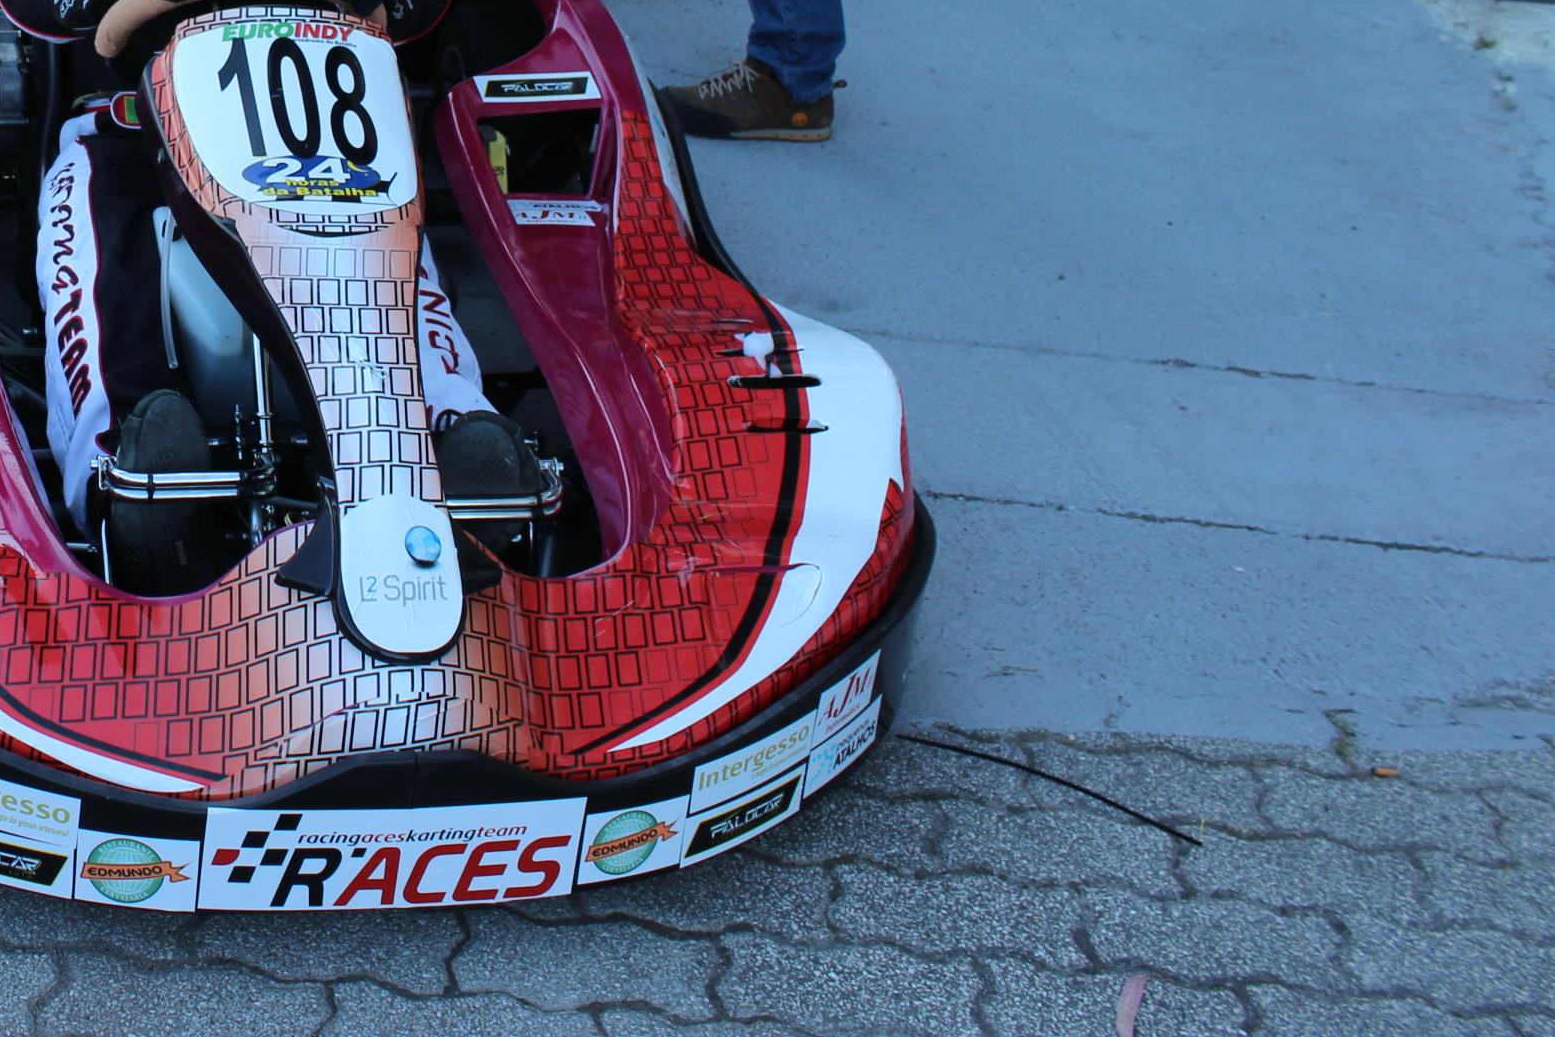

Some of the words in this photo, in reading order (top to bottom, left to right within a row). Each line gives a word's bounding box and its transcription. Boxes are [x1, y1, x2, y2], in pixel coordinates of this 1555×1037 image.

[222, 22, 356, 42] EUROINDY
[218, 37, 378, 165] 108
[263, 158, 351, 183] 24
[285, 178, 339, 187] horas
[263, 187, 289, 196] da
[297, 187, 378, 197] Batalha
[383, 574, 448, 607] Spirit
[698, 725, 809, 791] Intergesso
[833, 720, 876, 769] ATALHOS
[710, 792, 784, 838] PALOCAR
[298, 825, 527, 846] racingaceskartingteam
[592, 828, 658, 857] EDMUNDO
[87, 865, 163, 878] EDMUNDO
